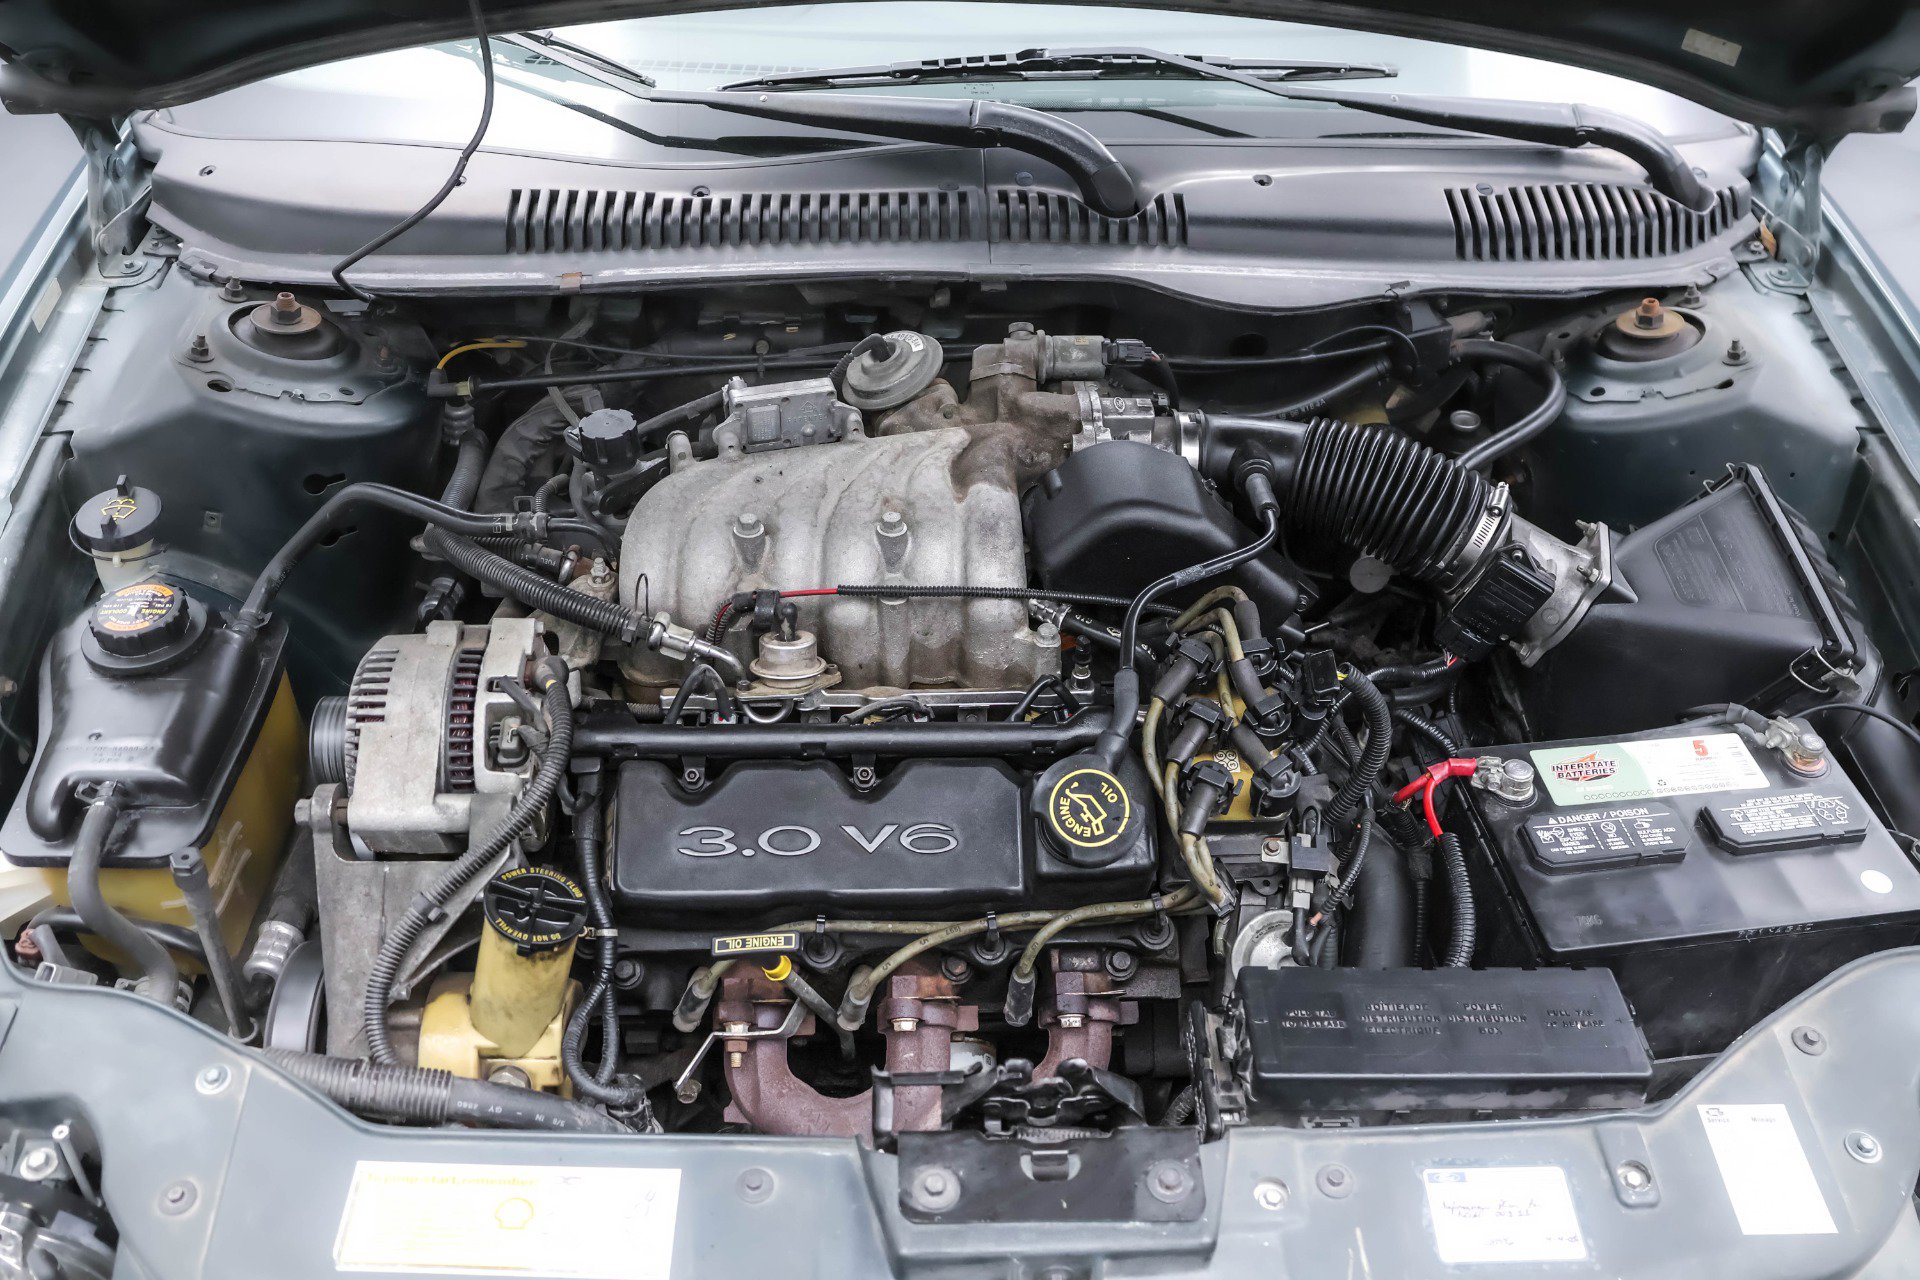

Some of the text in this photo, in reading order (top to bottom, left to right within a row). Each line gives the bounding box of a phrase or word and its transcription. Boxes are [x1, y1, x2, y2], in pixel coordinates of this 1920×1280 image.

[1692, 740, 1709, 757] 5
[1551, 760, 1617, 772] INTERSTATE
[1556, 767, 1616, 779] BATTERIES
[1060, 782, 1118, 837] ENGINE OIL
[1558, 813, 1600, 823] DANGER
[1610, 808, 1649, 817] POISON
[678, 824, 958, 857] 3.0 V6
[501, 868, 583, 898] POWER STEERING FLUID
[495, 918, 528, 940] OVERFILL
[550, 932, 561, 940] DO
[726, 936, 784, 949] ENGINE OIL
[1463, 1003, 1503, 1011] POWER
[1361, 1014, 1441, 1023] DISTRIBUTION
[1448, 1014, 1527, 1023] DISTRIBUTION
[1480, 1027, 1503, 1035] BOX
[488, 1105, 503, 1113] GY
[535, 1114, 544, 1122] IN
